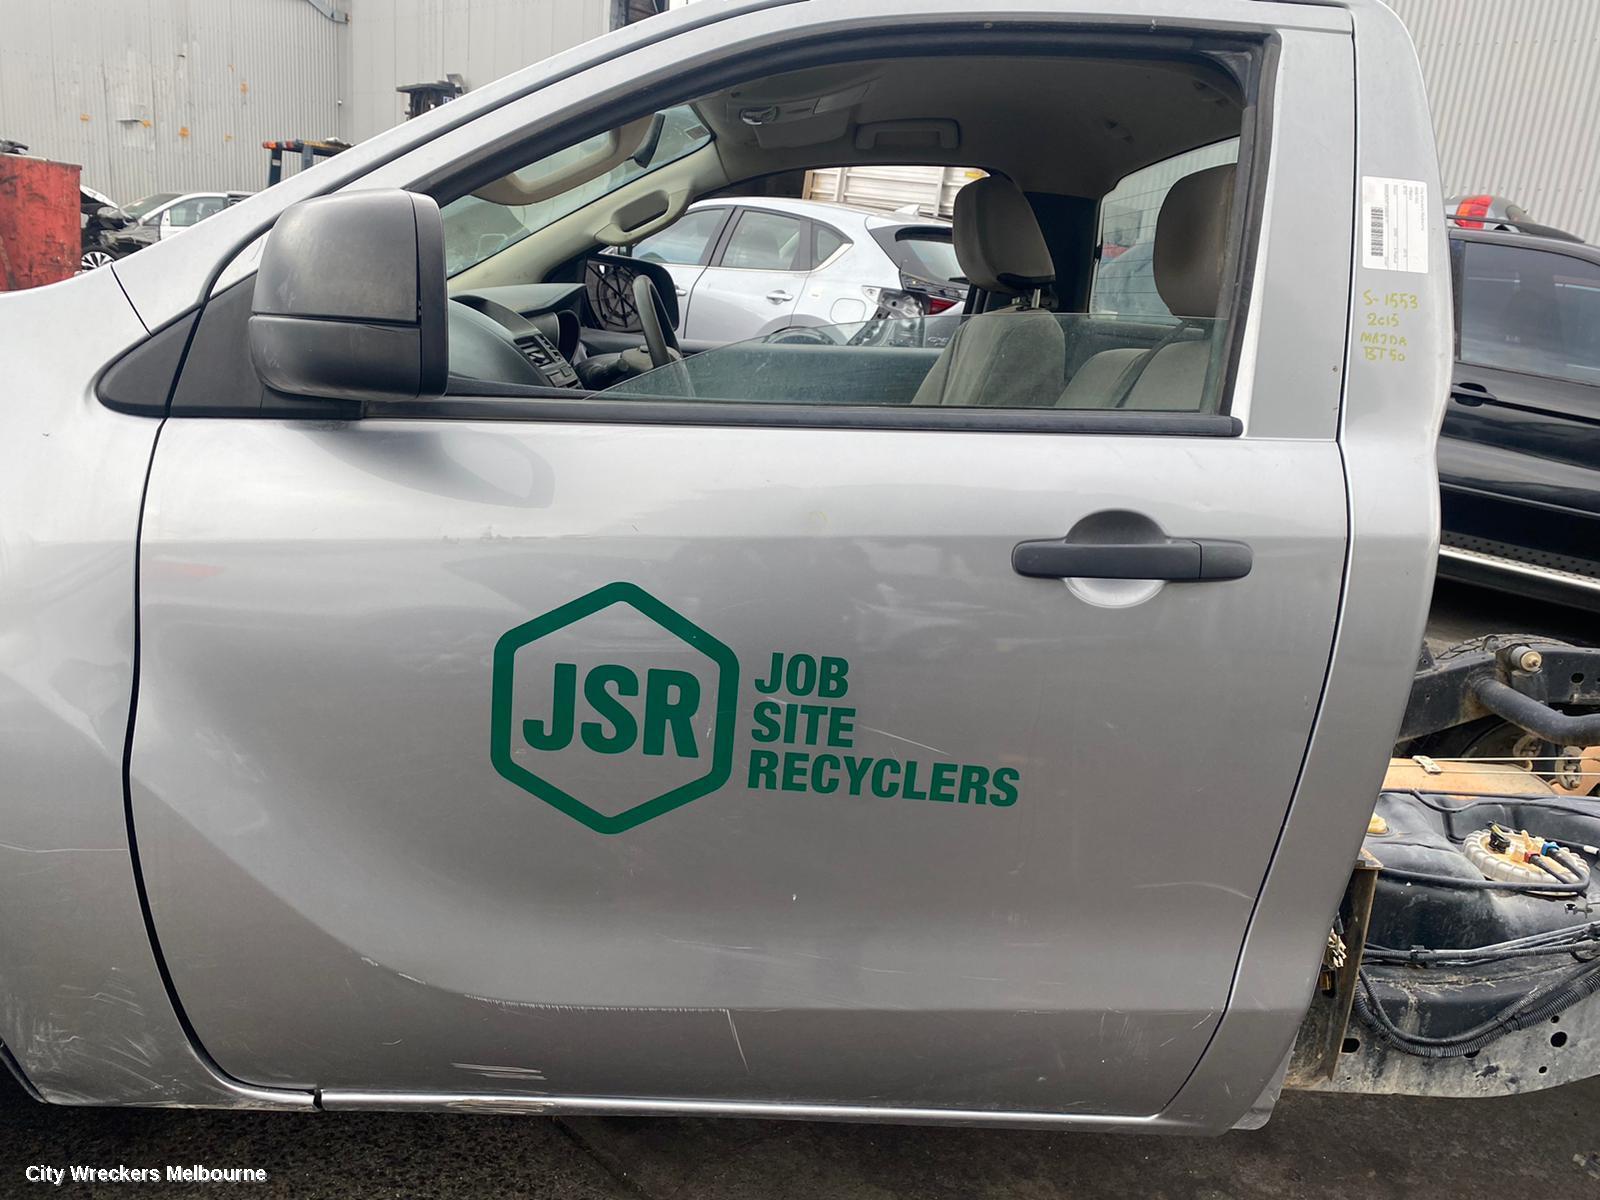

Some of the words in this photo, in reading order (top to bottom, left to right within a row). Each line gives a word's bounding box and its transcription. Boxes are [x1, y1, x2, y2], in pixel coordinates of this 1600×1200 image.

[754, 652, 850, 699] JOB
[522, 662, 701, 759] JSR
[751, 702, 857, 748] SITE
[747, 750, 1020, 807] RECYCLERS
